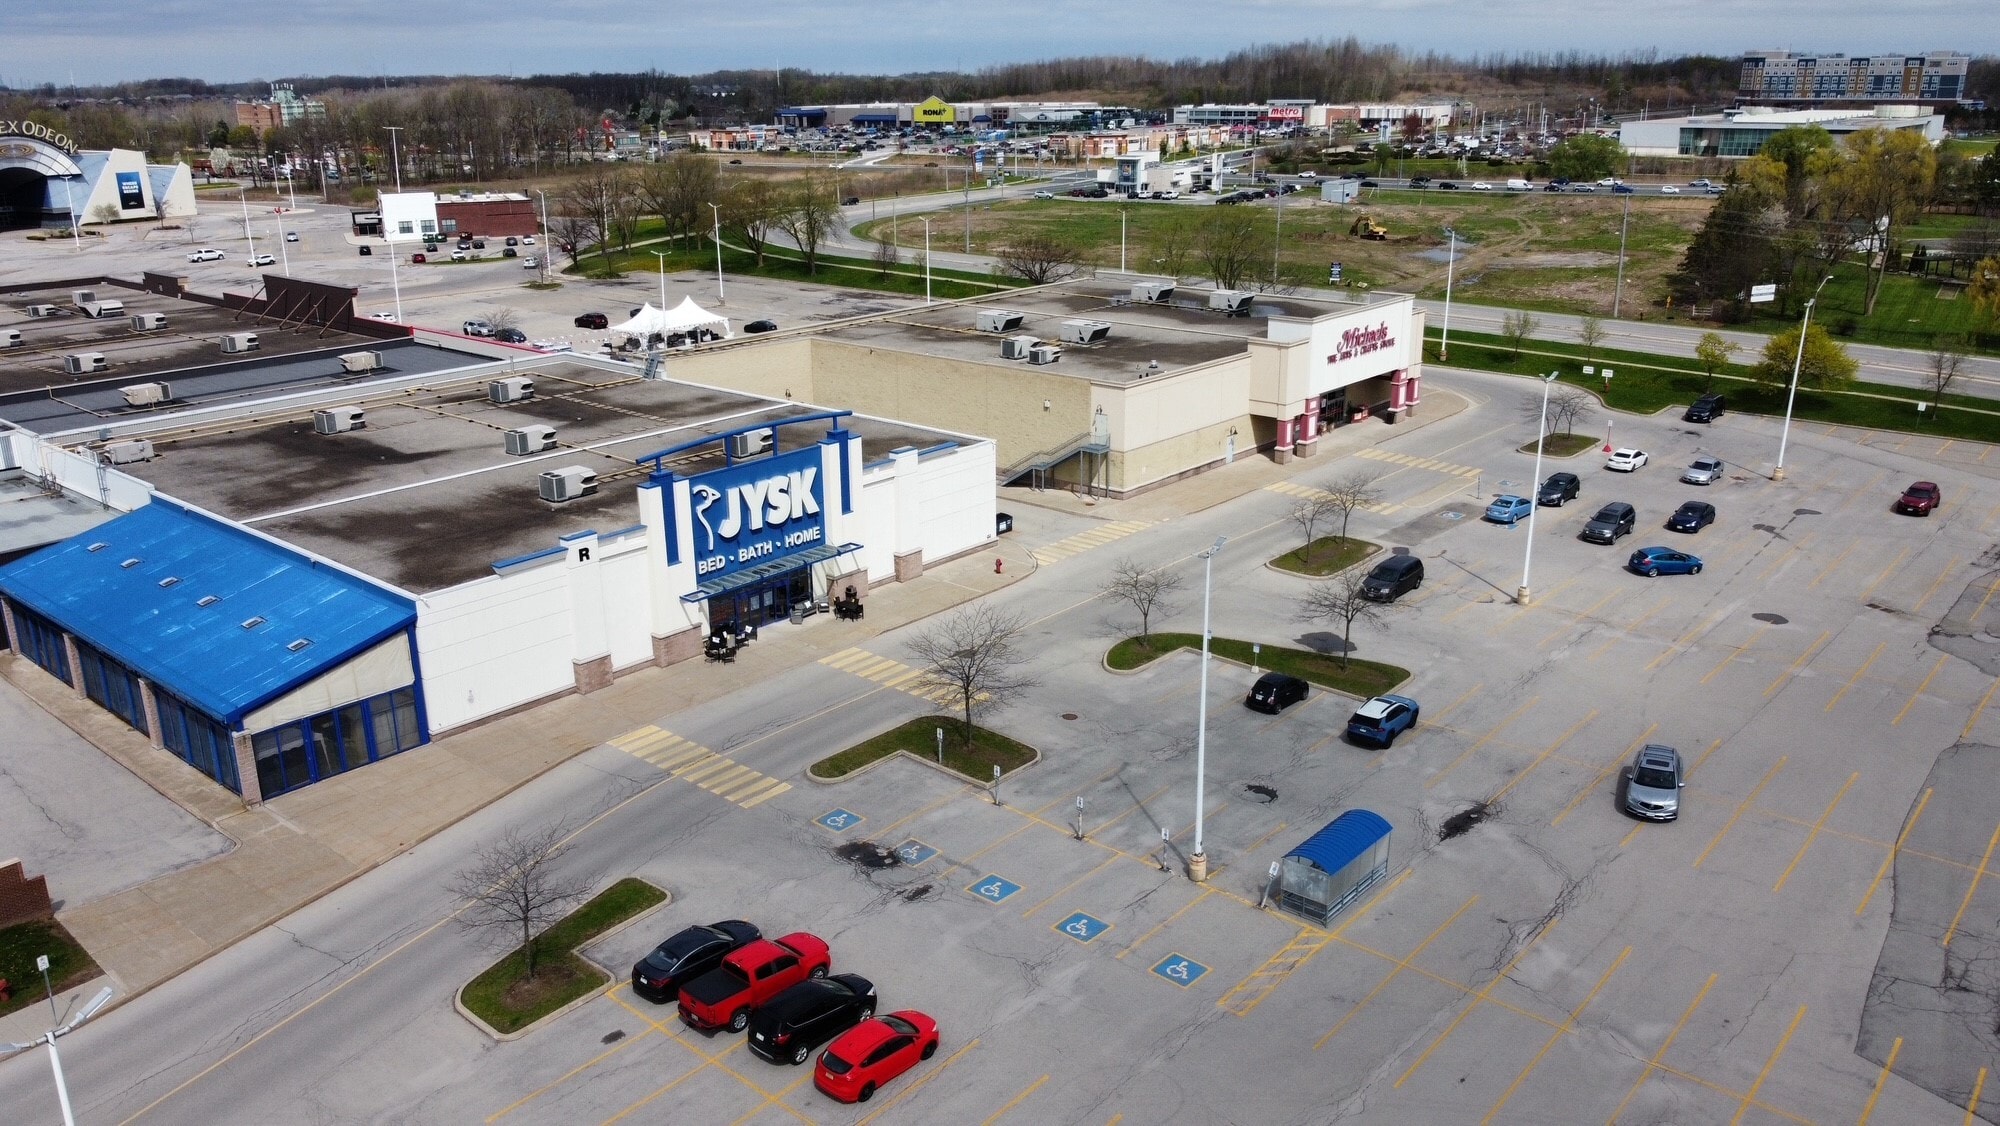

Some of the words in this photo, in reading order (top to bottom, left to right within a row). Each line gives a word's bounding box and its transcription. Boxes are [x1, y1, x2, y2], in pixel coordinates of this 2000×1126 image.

[1271, 107, 1299, 115] metro
[22, 120, 79, 154] ODEON
[1337, 321, 1388, 353] Michaels
[718, 467, 820, 538] JYSK
[579, 547, 590, 562] R
[698, 555, 726, 574] BED
[738, 540, 773, 562] BATH
[784, 526, 821, 548] HOME
